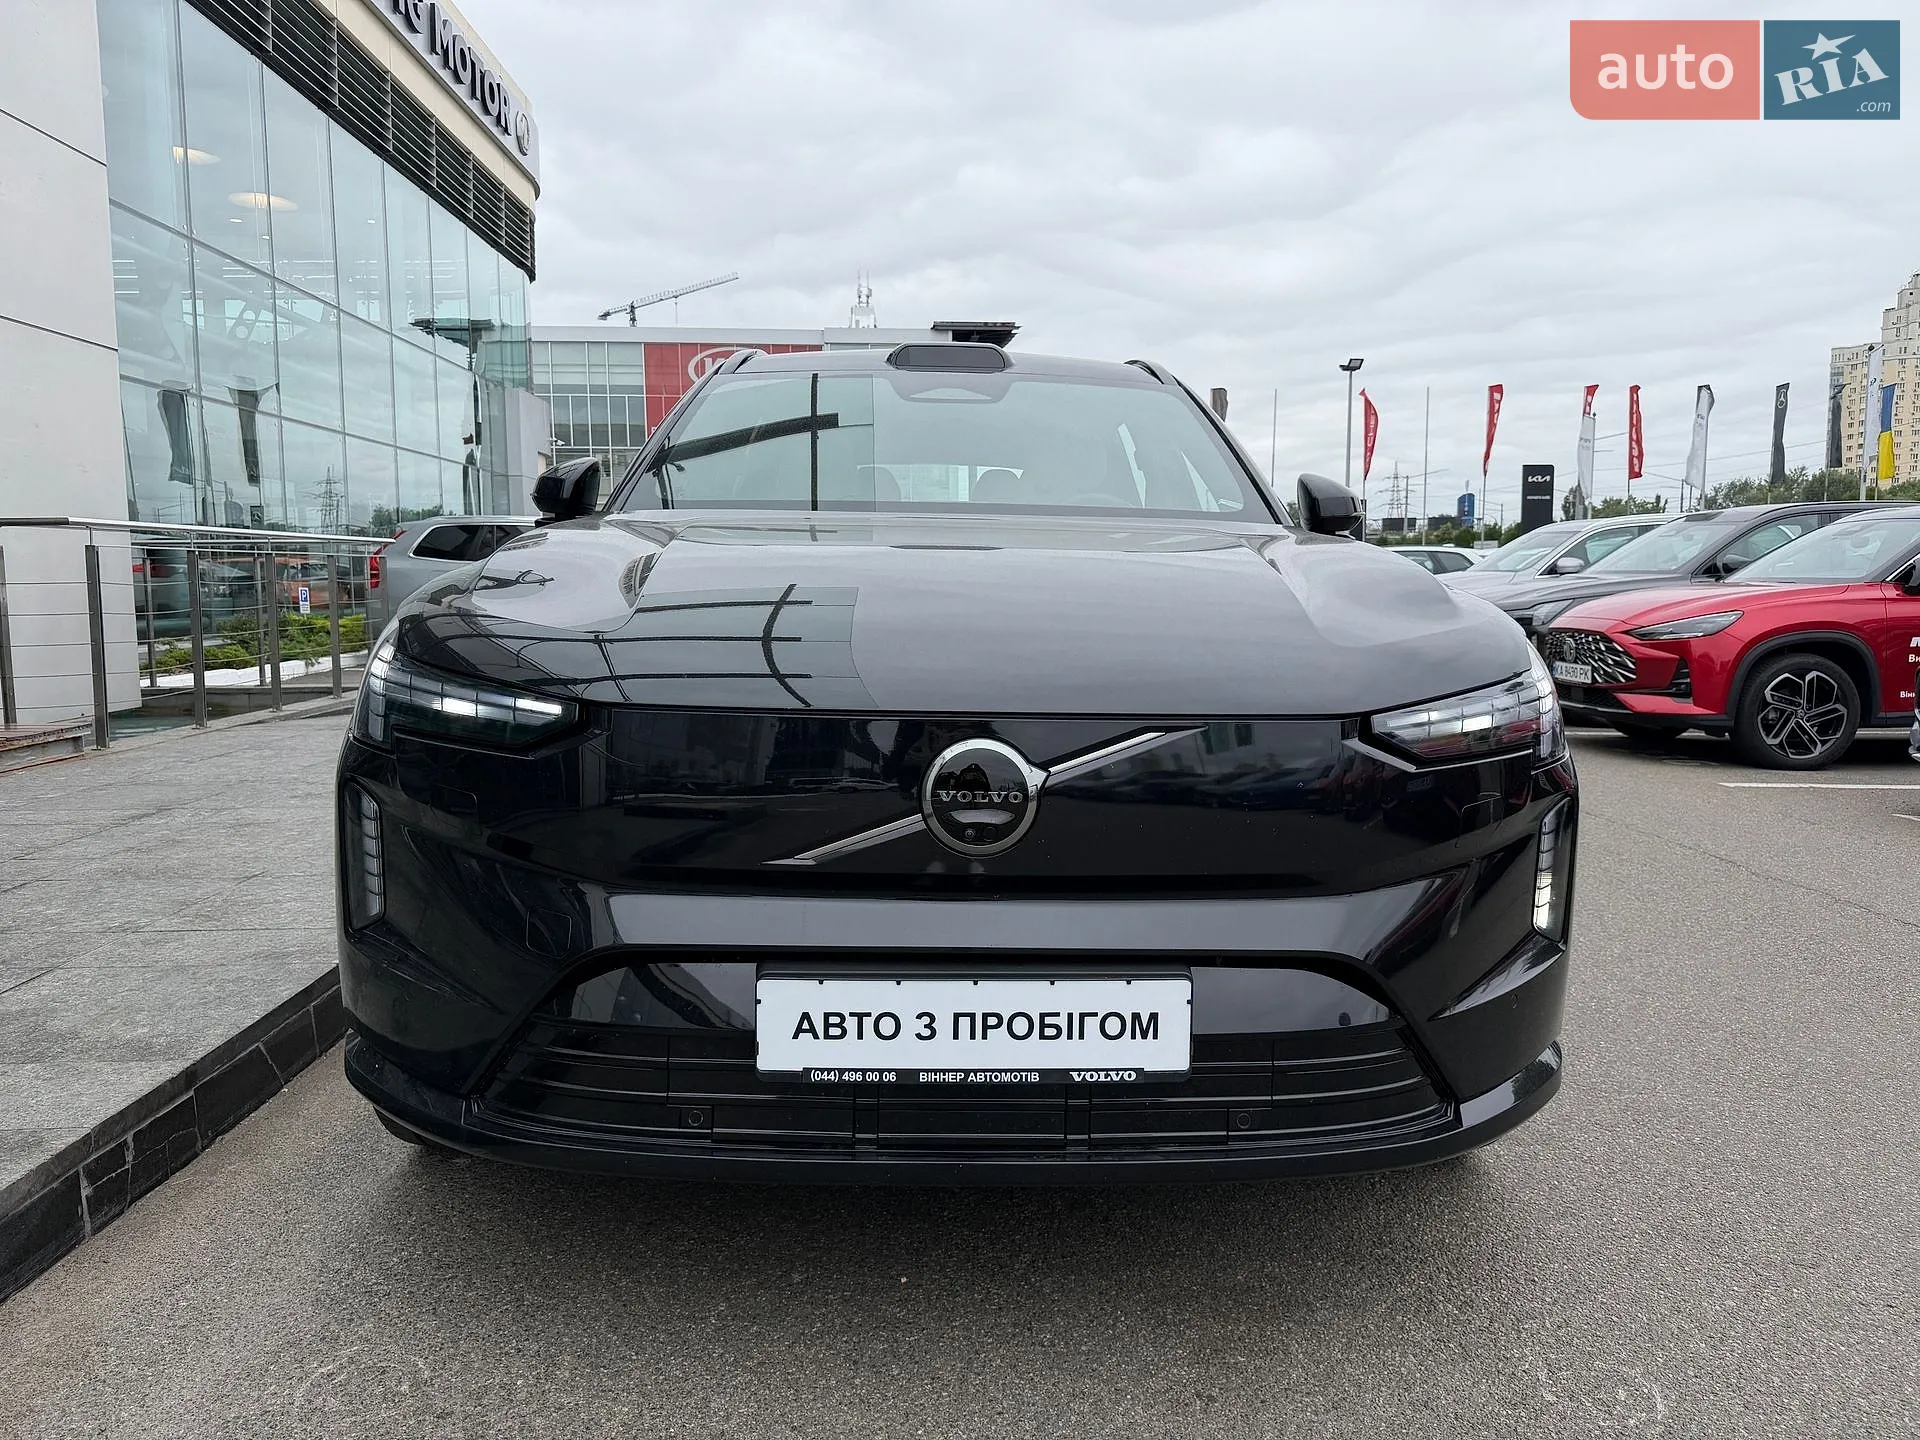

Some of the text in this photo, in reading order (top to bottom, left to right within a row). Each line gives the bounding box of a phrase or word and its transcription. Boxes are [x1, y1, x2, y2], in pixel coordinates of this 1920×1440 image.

[431, 2, 512, 136] MOTOR
[936, 790, 1024, 803] VOLVO
[792, 1011, 901, 1041] АВТО
[952, 1011, 1160, 1041] ПРОБІГОМ
[810, 1069, 1040, 1082] (044) 496 00 06 ВІННЕР АВТОМОТІВ
[1069, 1070, 1137, 1082] VOLVO
